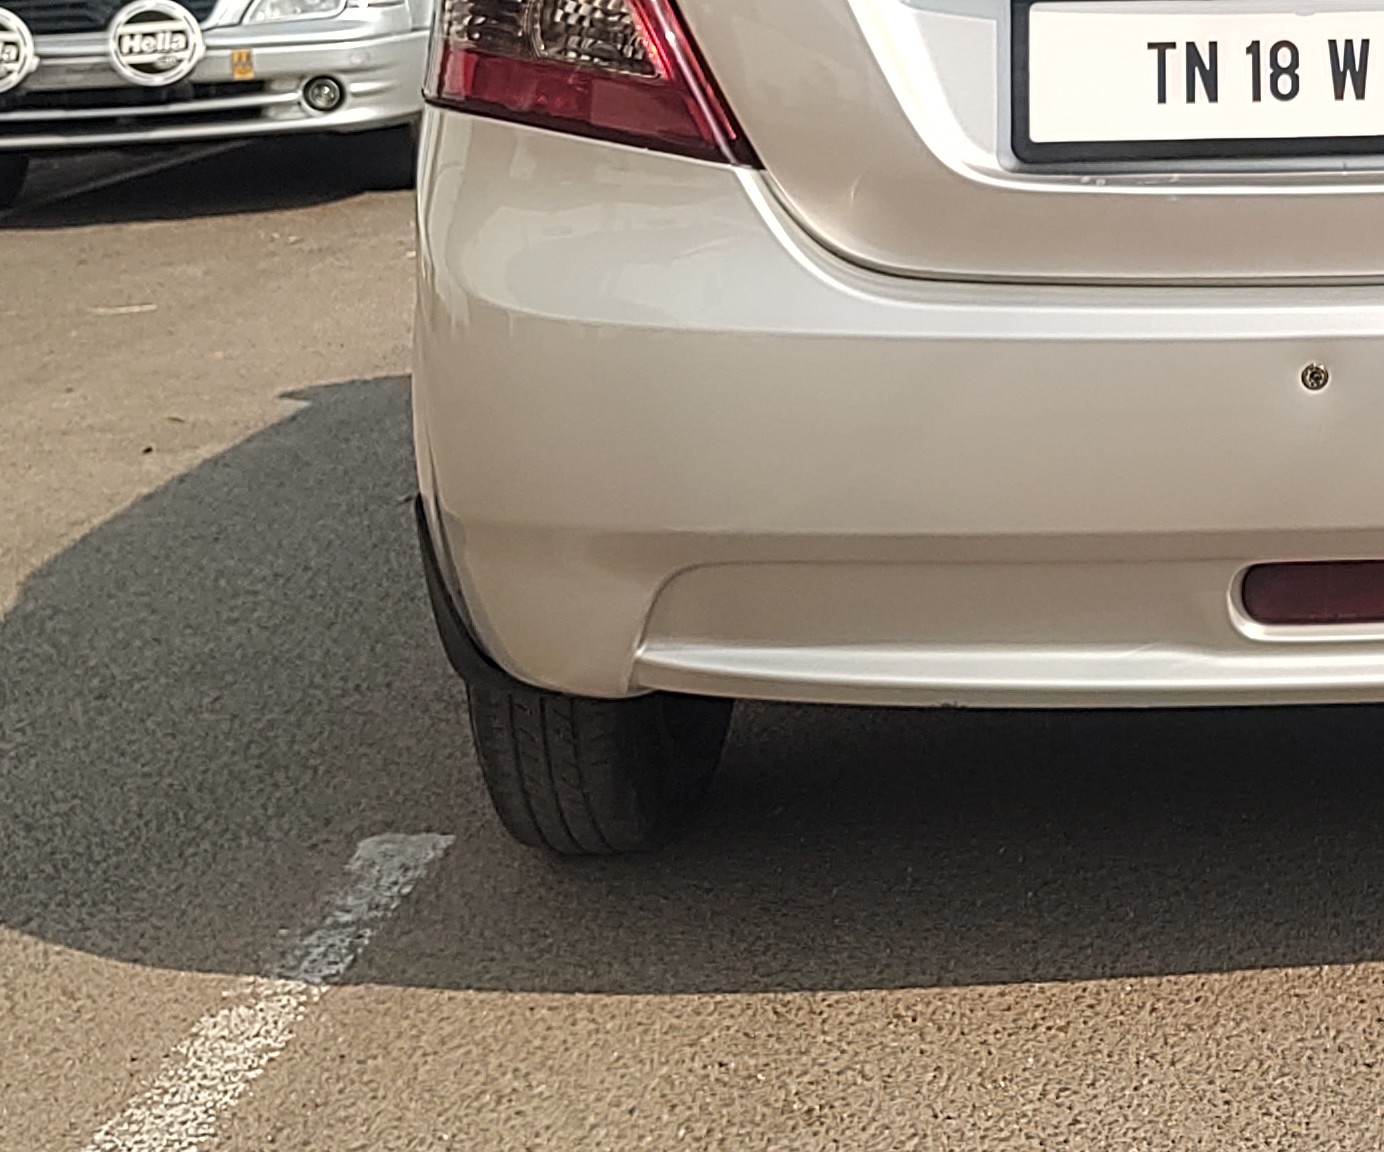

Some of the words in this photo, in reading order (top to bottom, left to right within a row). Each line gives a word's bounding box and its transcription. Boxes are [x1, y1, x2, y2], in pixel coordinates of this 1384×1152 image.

[121, 32, 187, 54] Hella
[1147, 40, 1218, 104] TN
[1245, 39, 1300, 102] 18
[1327, 38, 1370, 101] W
